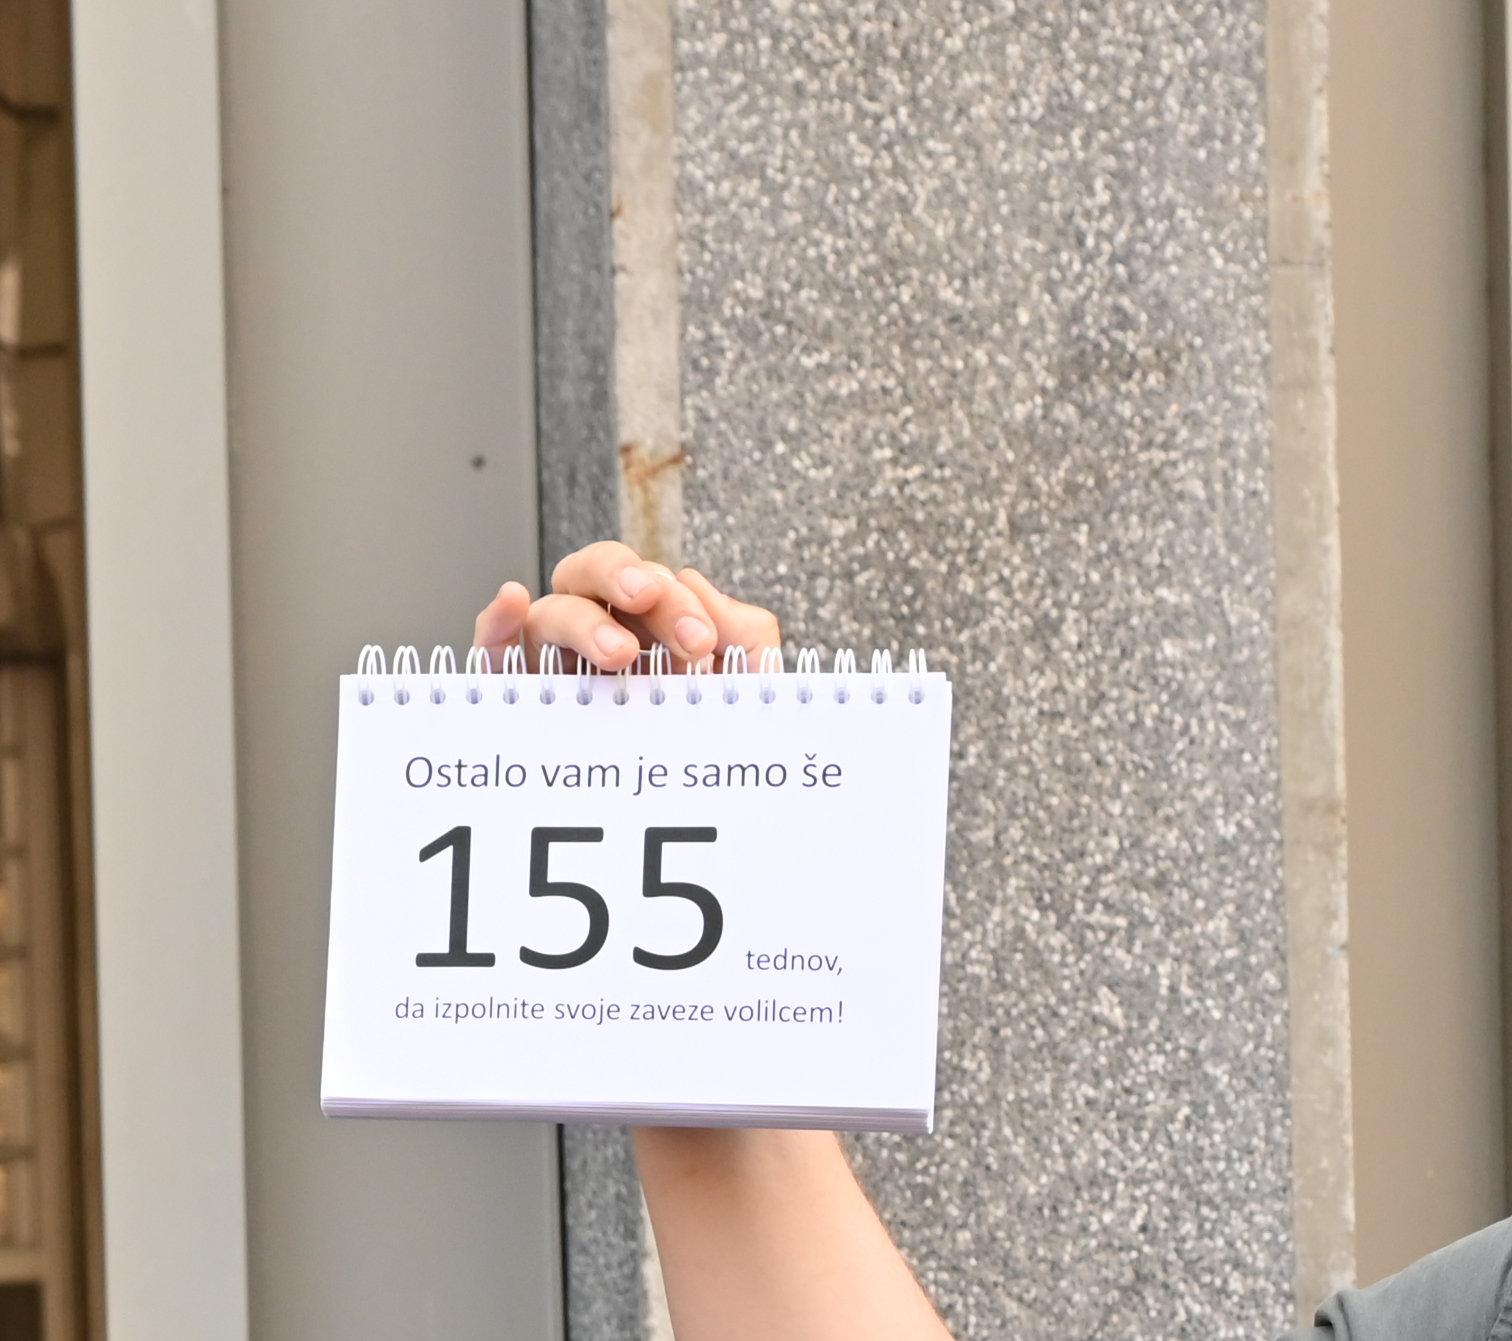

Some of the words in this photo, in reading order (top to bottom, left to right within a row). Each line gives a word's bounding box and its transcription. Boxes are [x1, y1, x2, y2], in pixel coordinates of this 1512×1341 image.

[405, 754, 526, 788] Ostalo
[540, 760, 620, 788] vam
[633, 755, 669, 796] je
[682, 760, 787, 788] samo
[801, 752, 842, 788] še
[416, 826, 723, 970] 155
[746, 948, 843, 976] tednov,
[394, 998, 424, 1020] da
[434, 998, 545, 1025] izpolnite
[554, 999, 620, 1026] svoje
[629, 1002, 715, 1022] zaveze
[724, 999, 844, 1025] volilcem!
